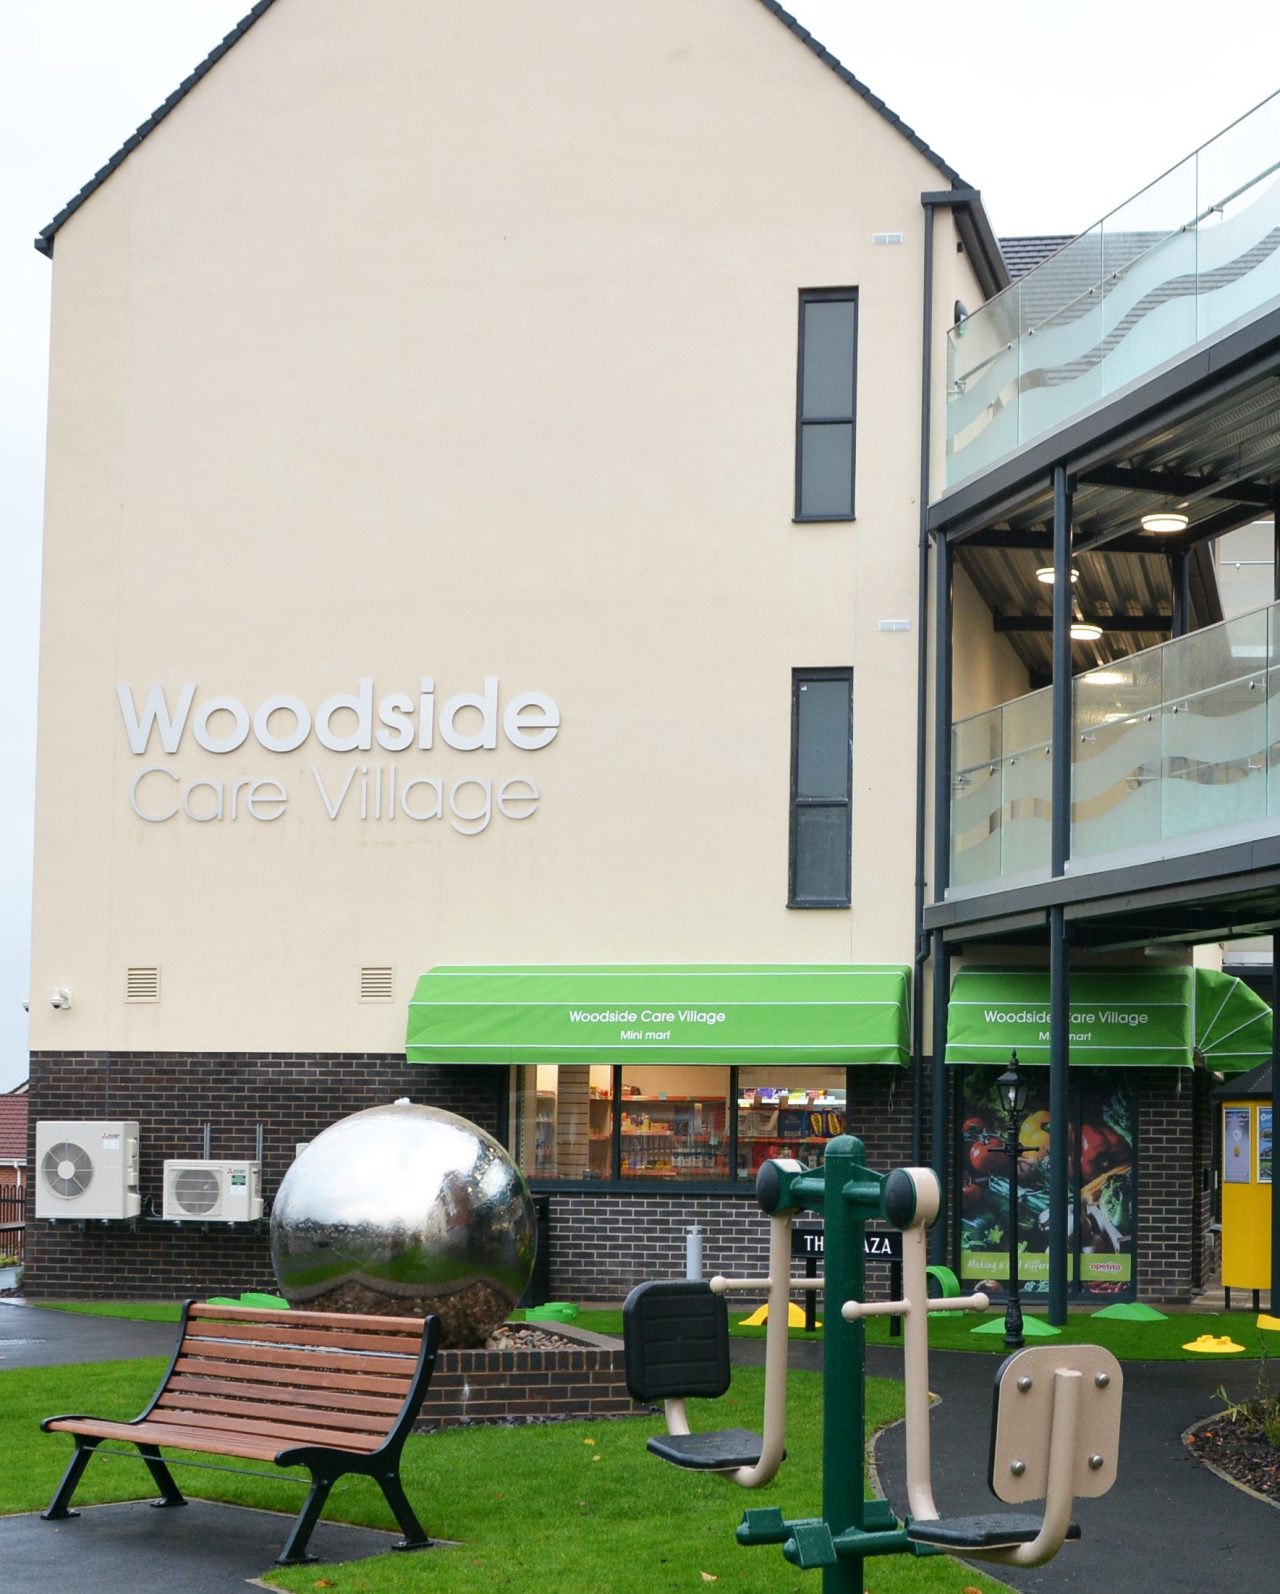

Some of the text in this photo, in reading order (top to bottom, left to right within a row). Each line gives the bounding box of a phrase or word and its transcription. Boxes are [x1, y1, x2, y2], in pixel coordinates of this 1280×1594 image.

[116, 676, 561, 755] Woodside
[129, 763, 541, 836] Care Village
[569, 1010, 726, 1025] Woodside Care Village
[1069, 1011, 1095, 1023] are
[1098, 1010, 1149, 1026] Village
[620, 1030, 671, 1040] Mini mart
[803, 1235, 824, 1252] TH
